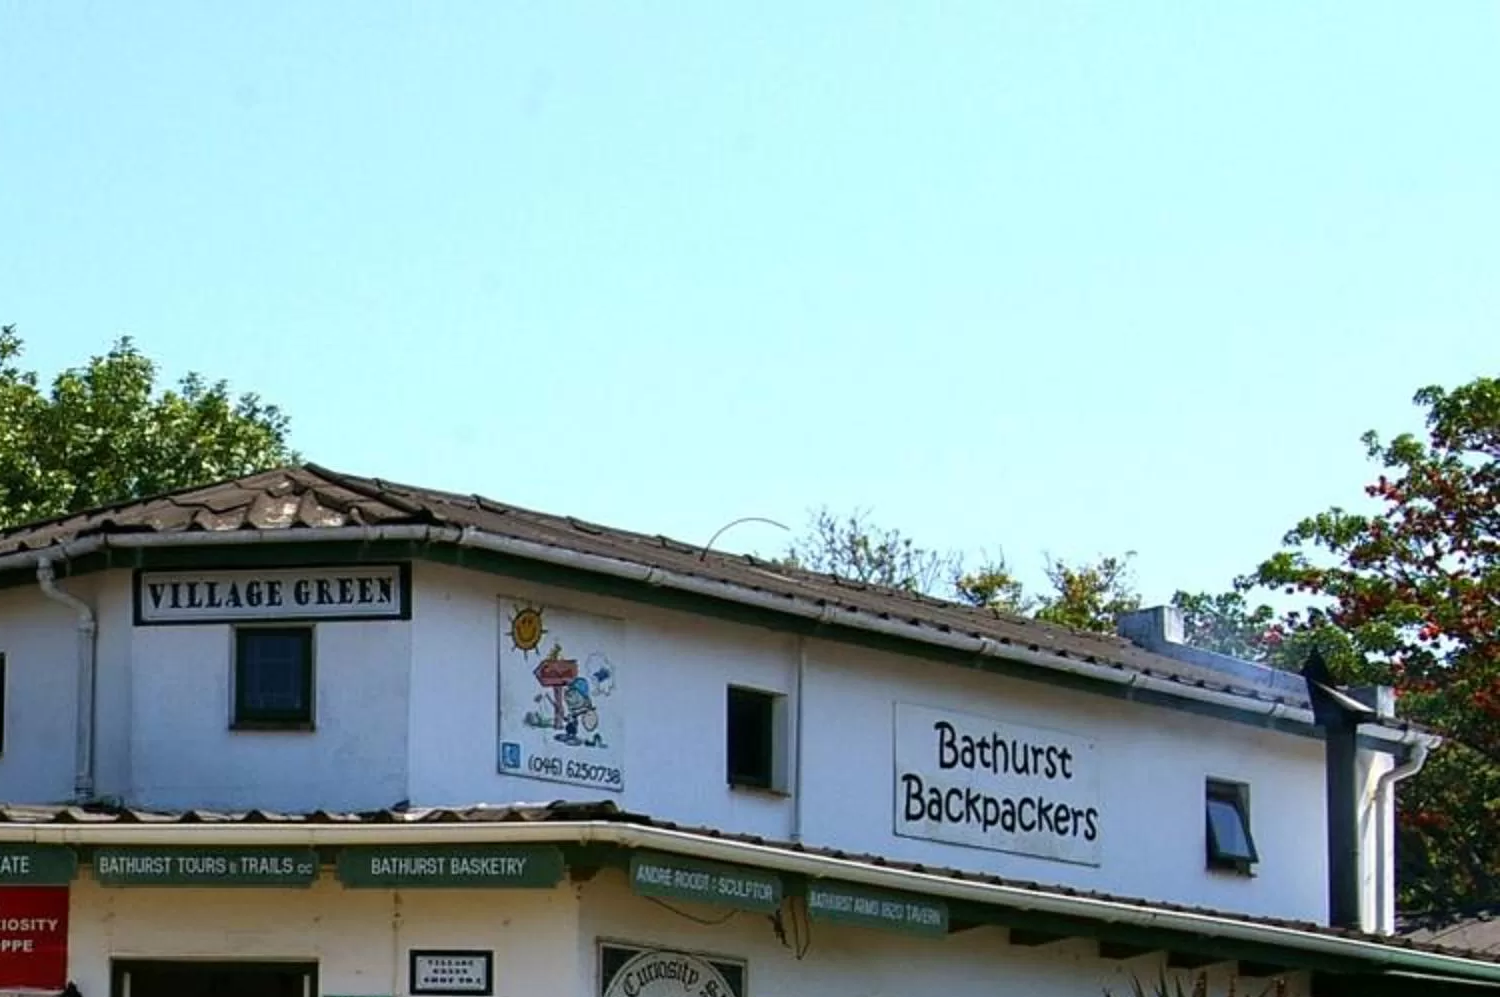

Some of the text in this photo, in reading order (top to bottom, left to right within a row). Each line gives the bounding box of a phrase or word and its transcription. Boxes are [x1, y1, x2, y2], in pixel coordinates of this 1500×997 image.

[147, 576, 393, 609] VILLAGE GREEN
[934, 721, 1073, 779] Bathurst
[901, 773, 1099, 841] Backpackers
[100, 856, 171, 874] BATHURST
[178, 856, 227, 874] TOURS
[241, 856, 294, 874] TRAILS
[371, 857, 527, 875] BATHURST BASKETRY
[718, 876, 773, 900] SCULPTOR
[905, 903, 942, 925] TAVERN
[624, 961, 699, 997] Curiosity
